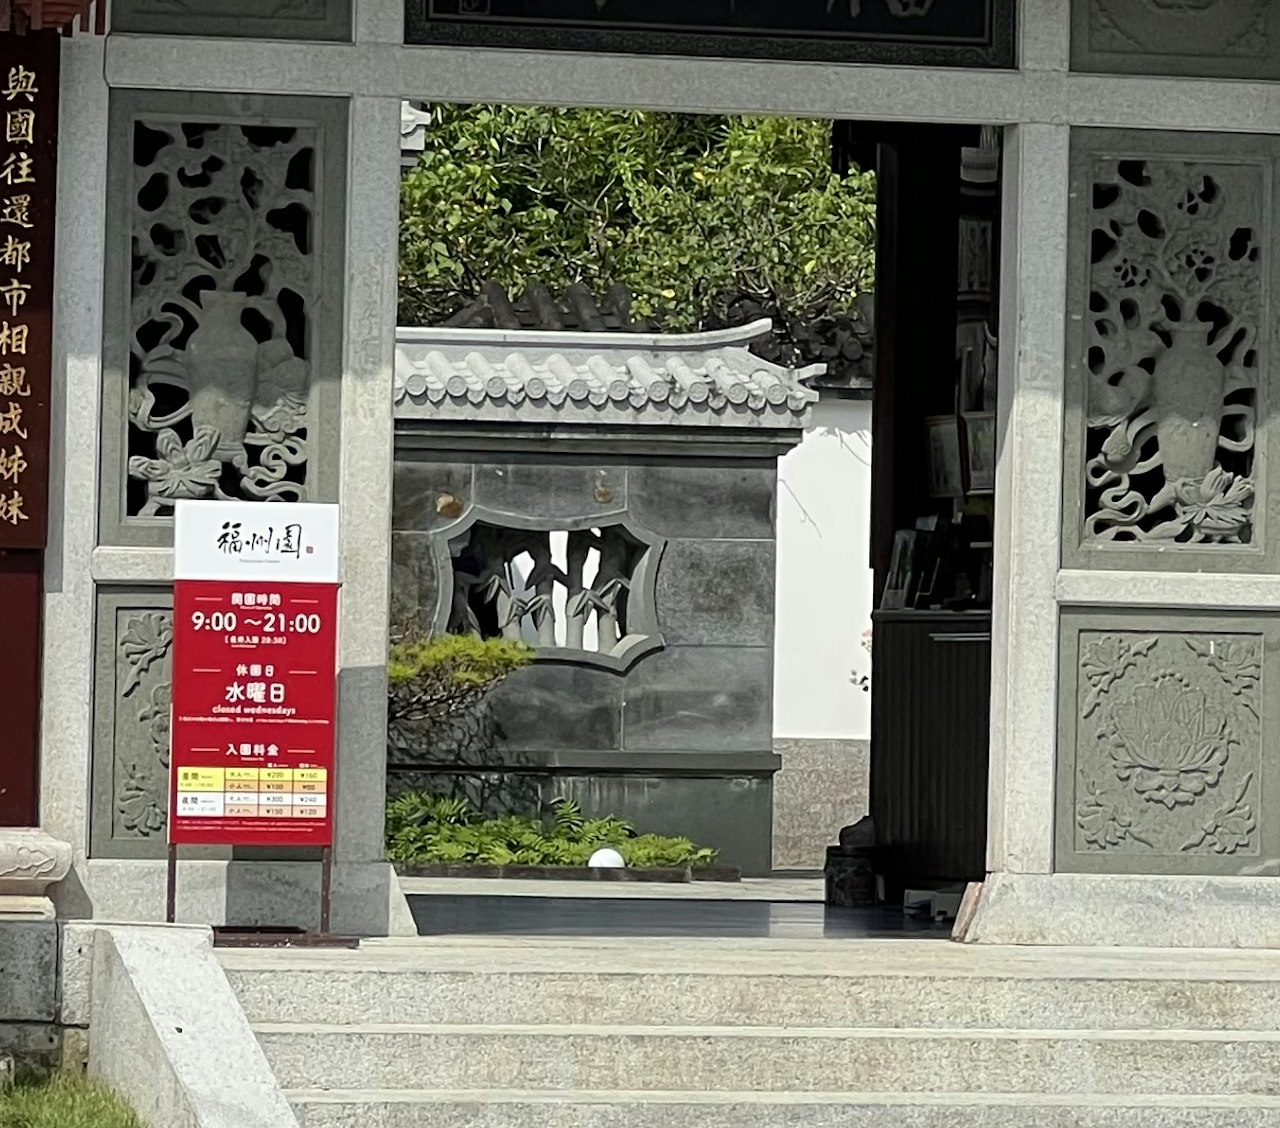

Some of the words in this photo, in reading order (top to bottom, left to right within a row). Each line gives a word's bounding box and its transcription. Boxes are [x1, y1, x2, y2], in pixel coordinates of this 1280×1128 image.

[191, 611, 237, 632] 9:00
[225, 681, 285, 703] 水曜日
[212, 704, 241, 714] closed
[244, 706, 296, 716] wednesdays
